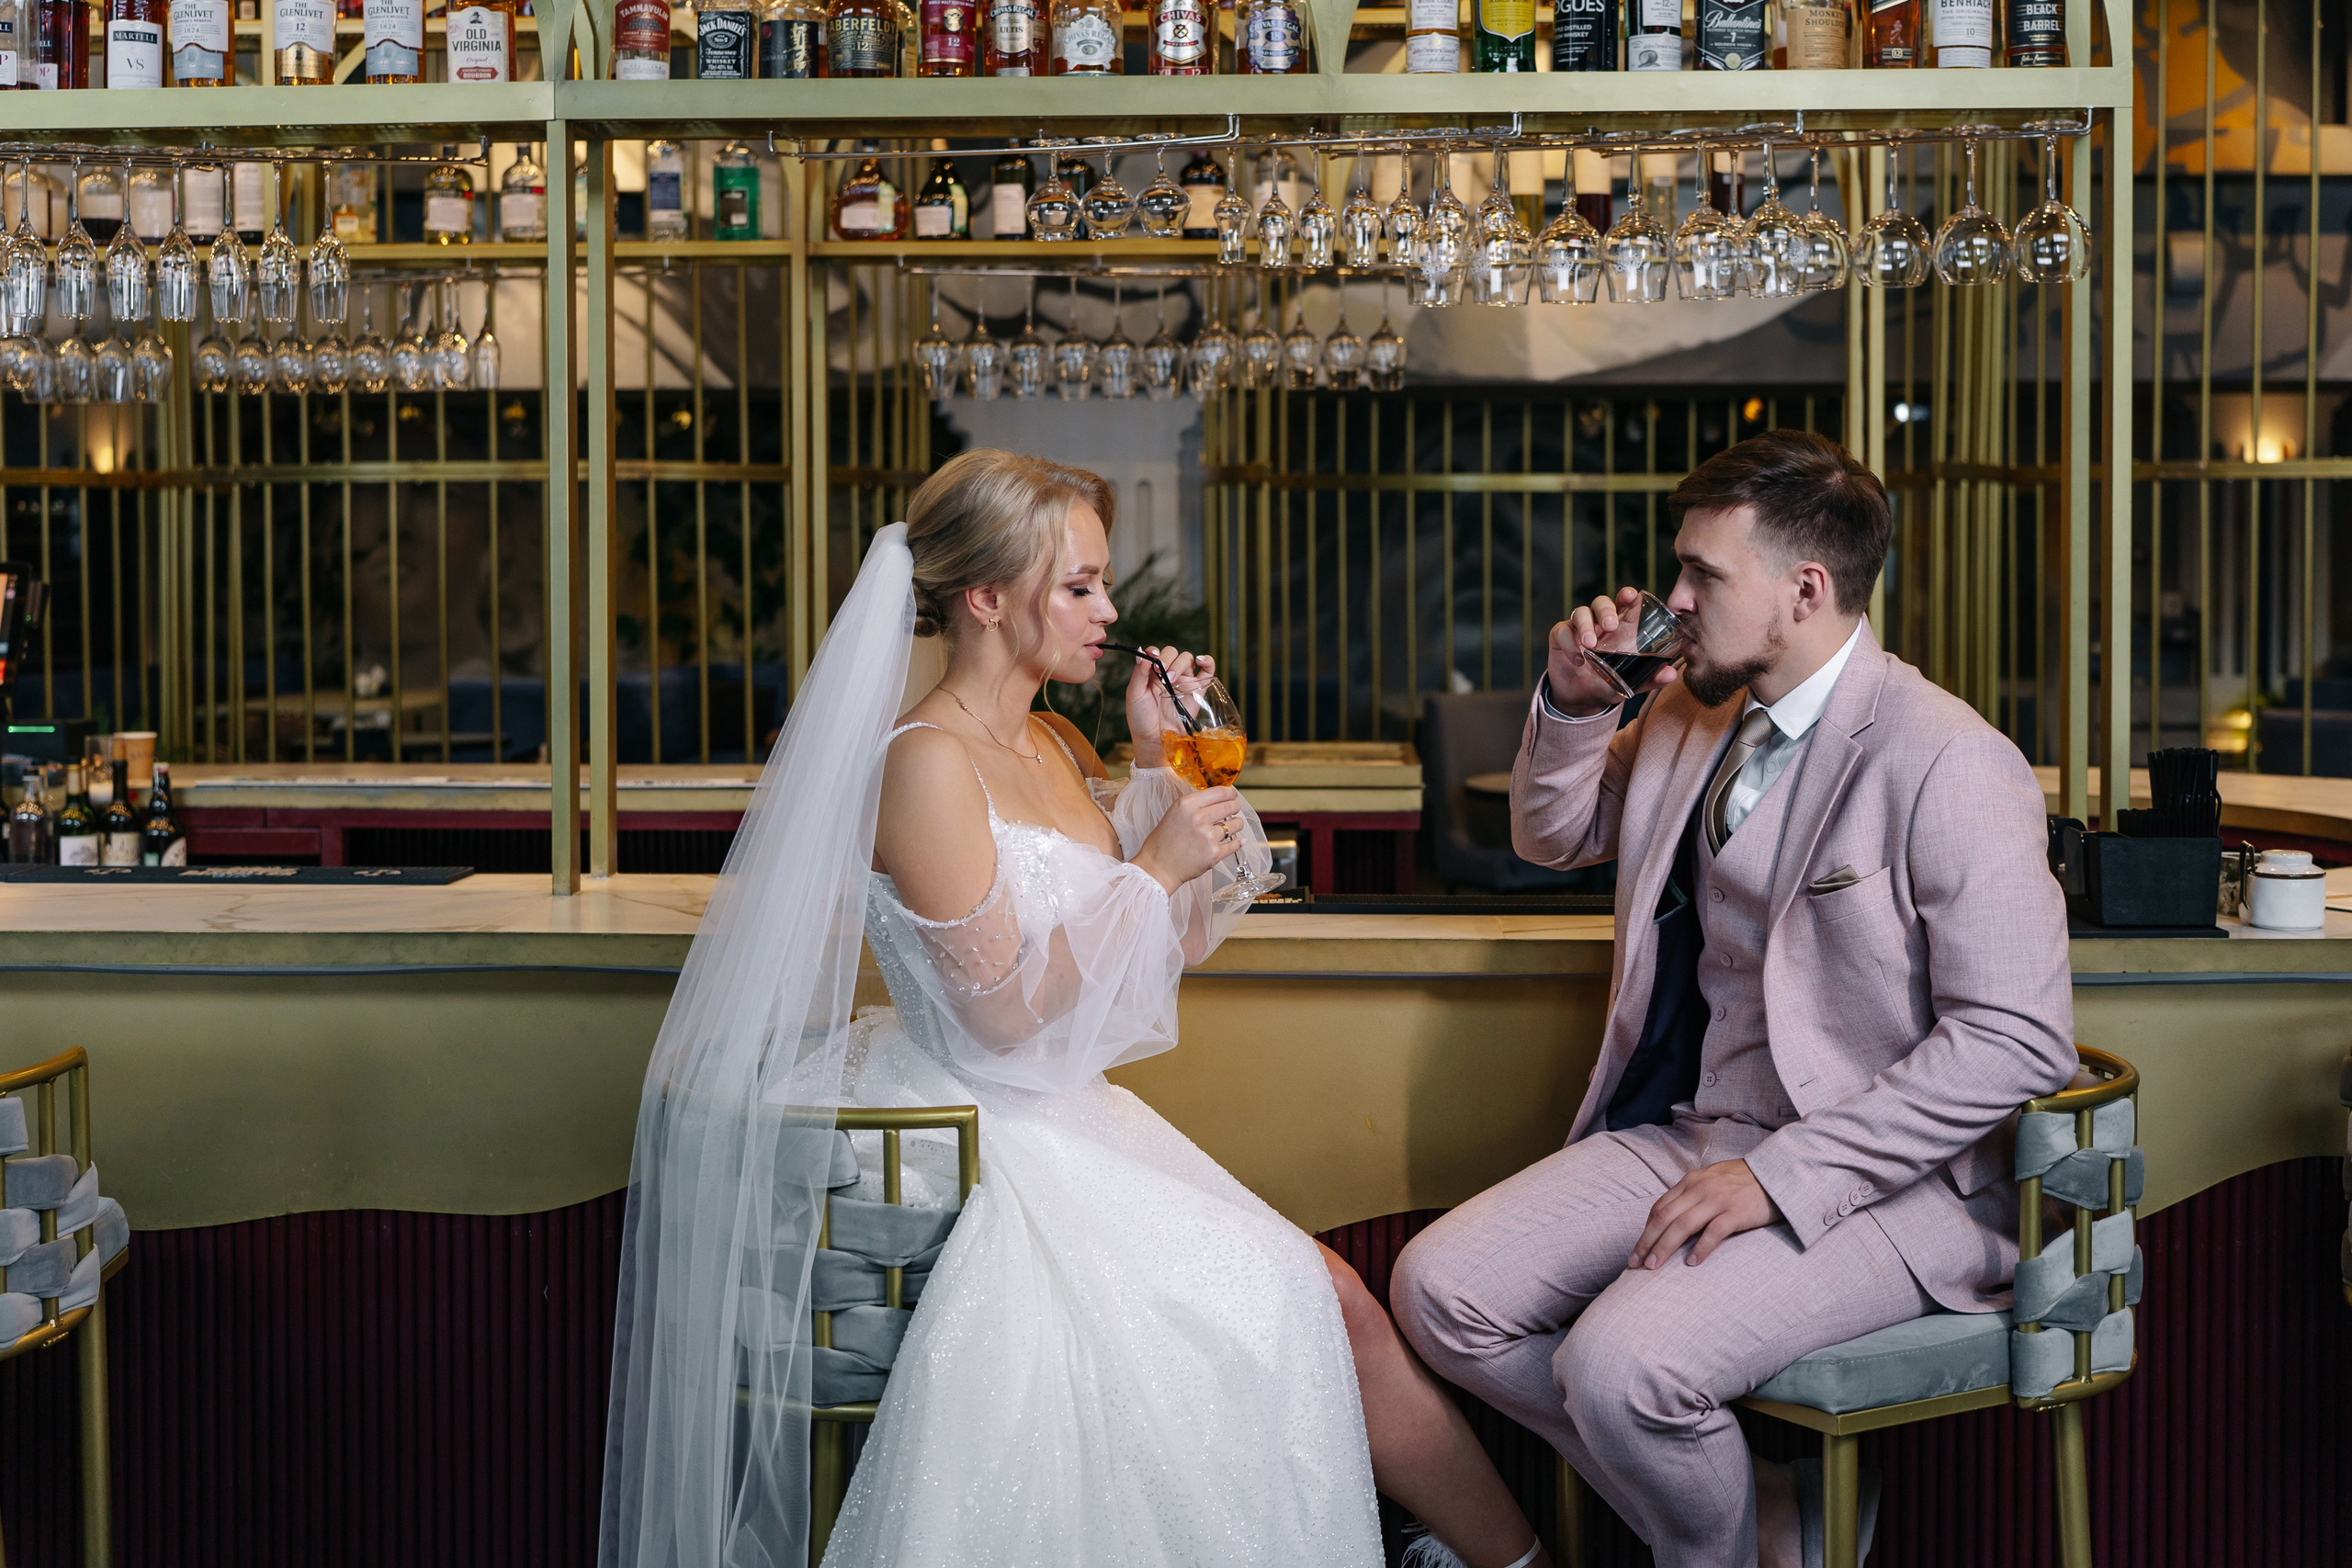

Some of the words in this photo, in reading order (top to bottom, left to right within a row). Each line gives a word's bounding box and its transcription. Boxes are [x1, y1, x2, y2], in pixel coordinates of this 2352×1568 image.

[174, 10, 214, 20] GLENLIVET
[280, 8, 323, 19] GLENLIVET
[368, 6, 411, 16] GLENLIVET
[619, 4, 669, 21] TAMNAVULIN
[990, 6, 1012, 17] CHIVAS
[1012, 5, 1035, 17] REGAL
[2026, 4, 2058, 15] BLACK
[1160, 11, 1202, 23] CHIVAS
[1704, 9, 1762, 28] Ballantine's
[296, 23, 306, 31] 12
[699, 20, 717, 36] JACK
[717, 17, 746, 37] DANIEL'S
[830, 18, 895, 34] ABERFELDY
[1250, 19, 1276, 33] CHIVAS
[1278, 19, 1299, 33] REGAL
[2023, 19, 2061, 31] BARREL
[115, 31, 155, 42] MARTELL
[466, 28, 487, 39] OLD
[1064, 30, 1090, 45] CHIVAS
[1091, 29, 1115, 46] REGAL
[1271, 31, 1281, 41] 18
[1731, 31, 1736, 43] 7
[1966, 28, 1975, 36] 10
[452, 40, 502, 51] VIRGINIA
[857, 41, 869, 51] 12
[947, 37, 960, 47] 12
[127, 58, 144, 71] VS
[466, 57, 489, 65] Original
